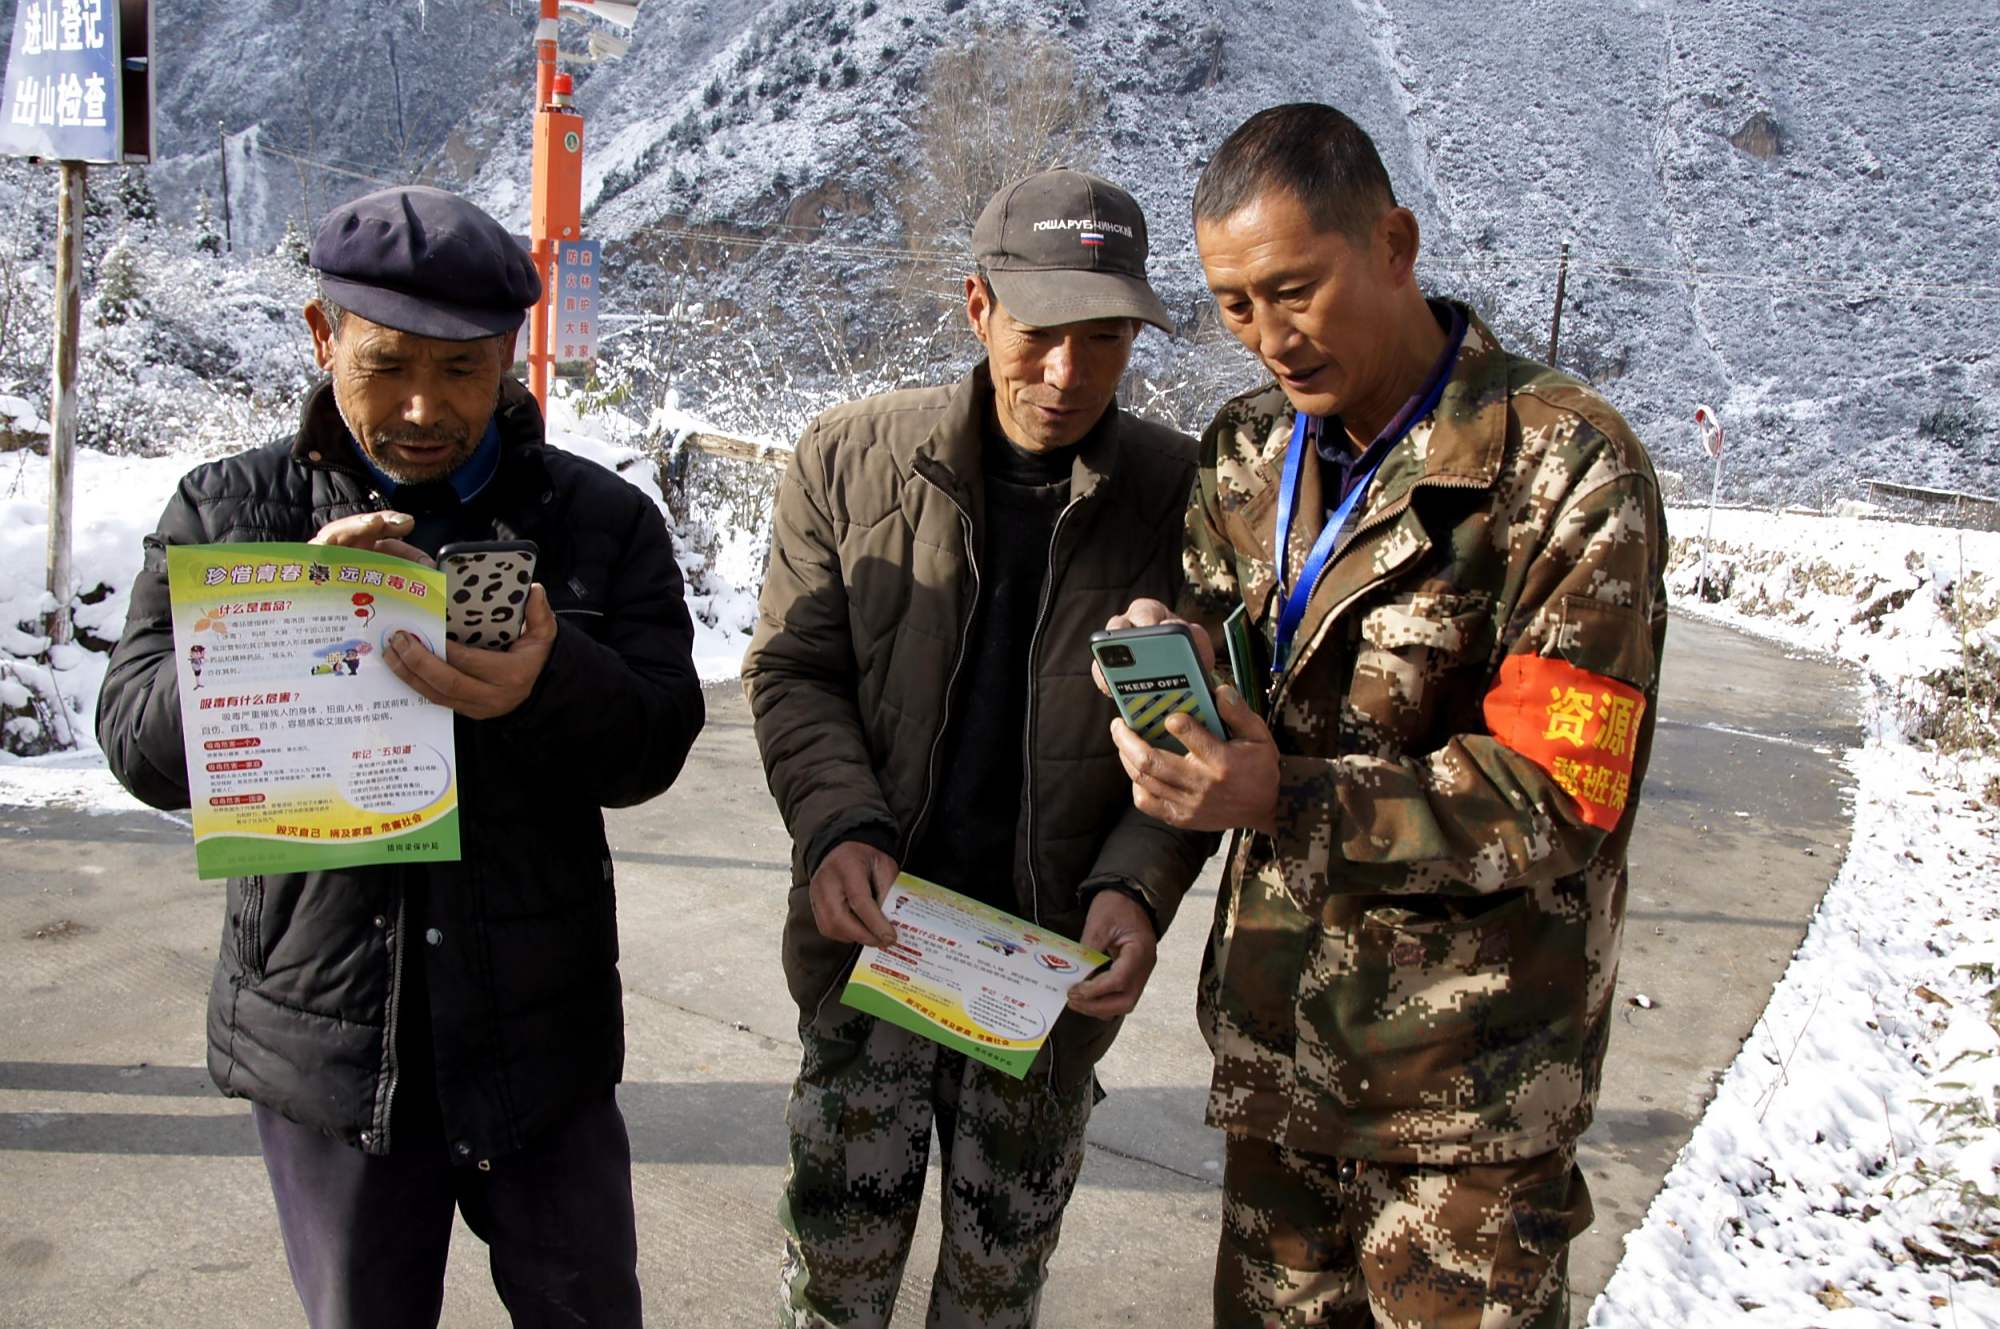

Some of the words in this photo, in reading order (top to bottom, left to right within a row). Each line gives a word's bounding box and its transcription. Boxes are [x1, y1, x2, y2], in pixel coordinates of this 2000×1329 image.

[21, 0, 105, 55] 进山登记
[11, 72, 107, 127] 出山检查
[204, 563, 303, 585] 珍惜青春
[339, 566, 428, 597] 远离毒品
[381, 813, 422, 832] 危害社会
